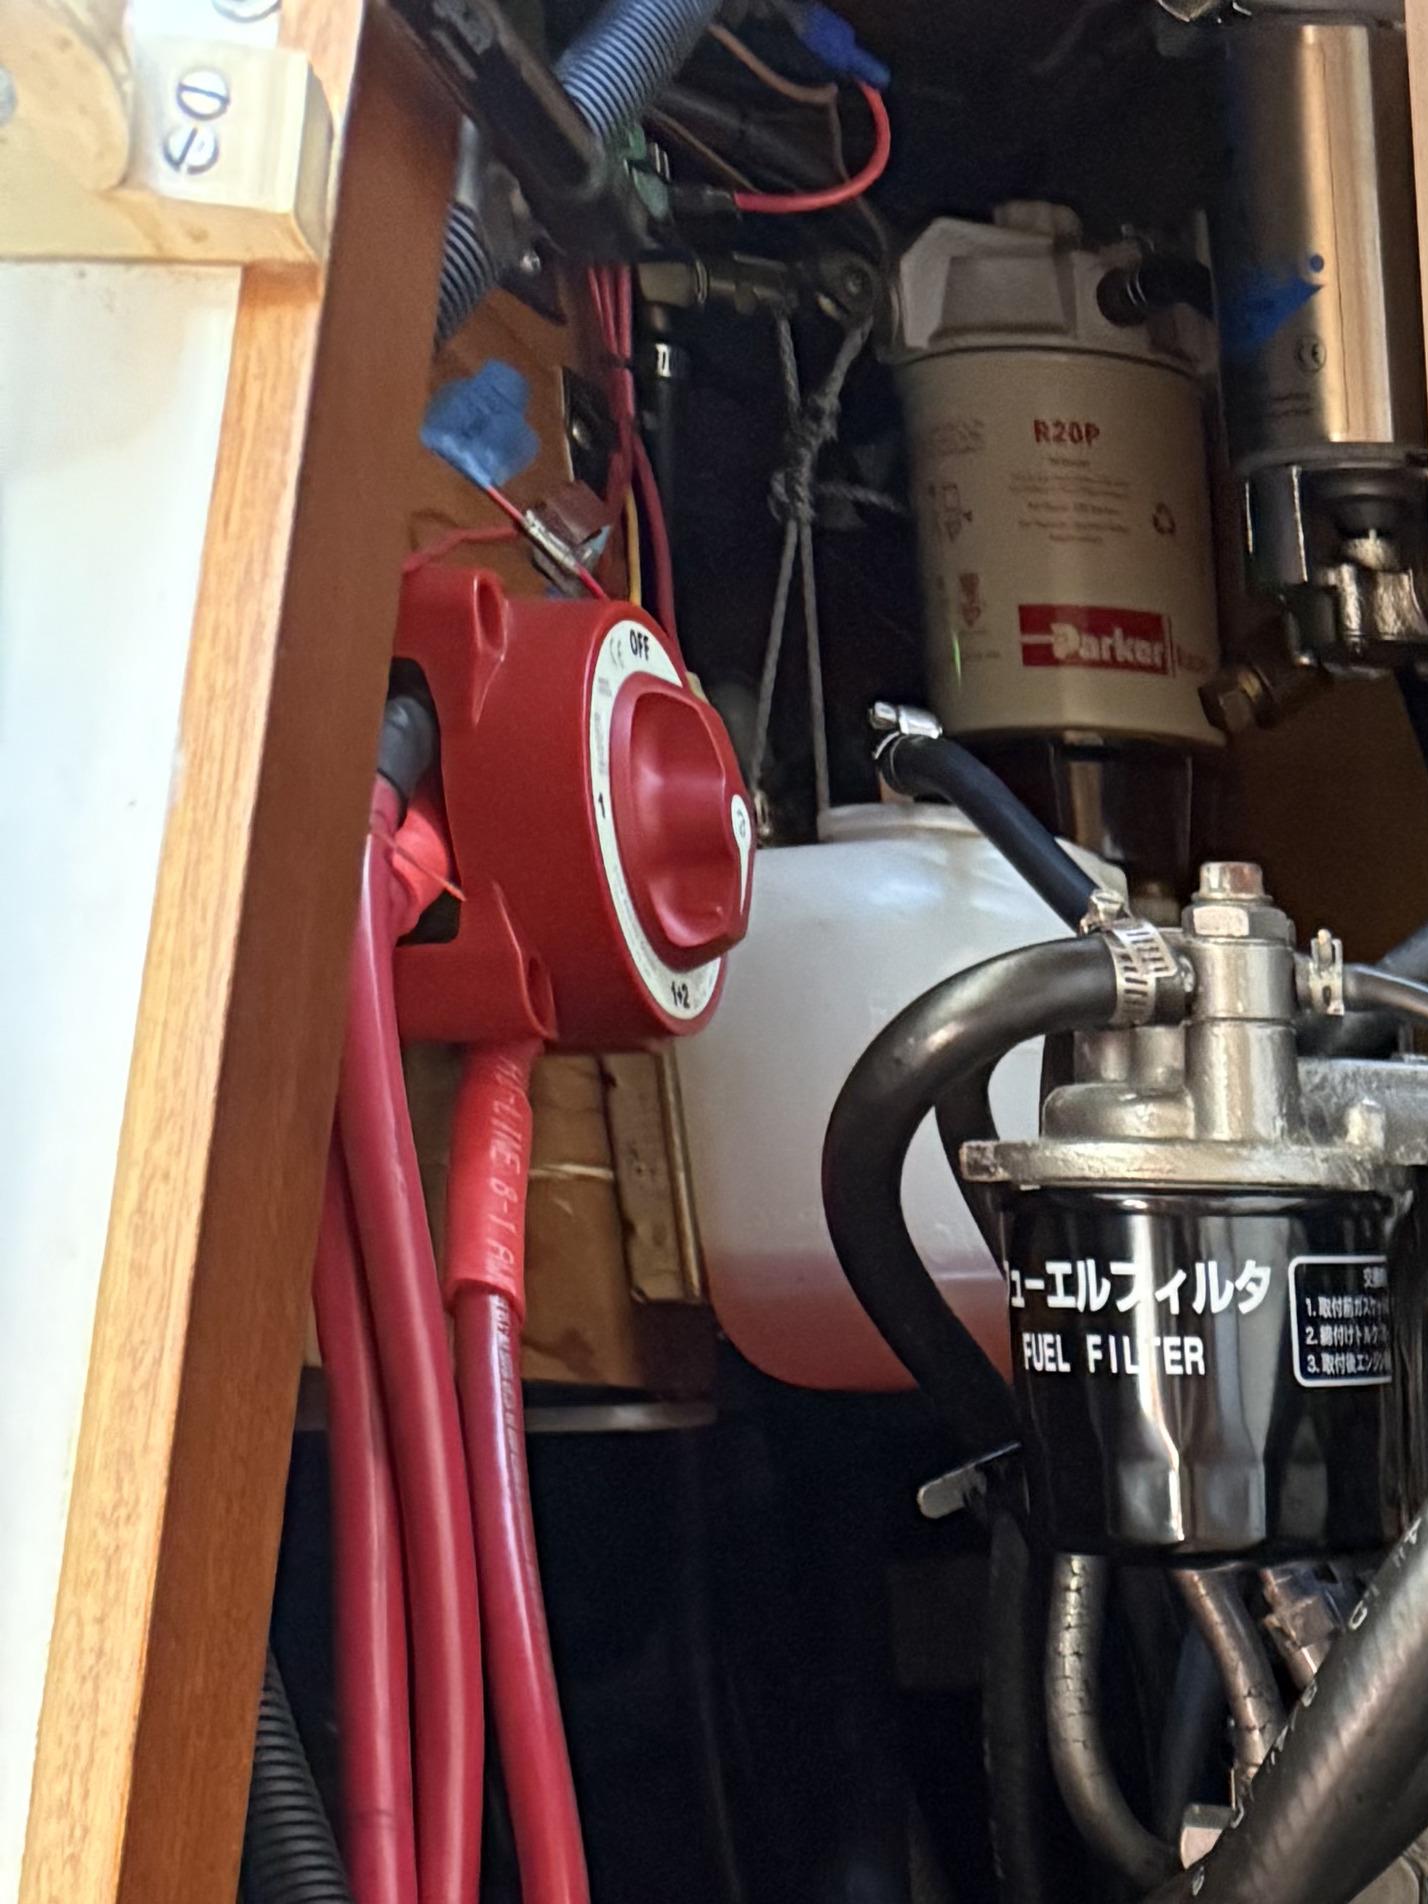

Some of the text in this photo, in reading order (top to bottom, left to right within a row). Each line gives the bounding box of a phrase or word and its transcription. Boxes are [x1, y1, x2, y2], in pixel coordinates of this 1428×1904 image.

[1033, 419, 1100, 446] R20P
[629, 628, 650, 661] OFF
[1050, 622, 1168, 669] Parker
[670, 980, 691, 1010] 1+2
[1004, 1258, 1271, 1316] ューエルフィルタ
[1022, 1333, 1206, 1375] FUEL FILTER
